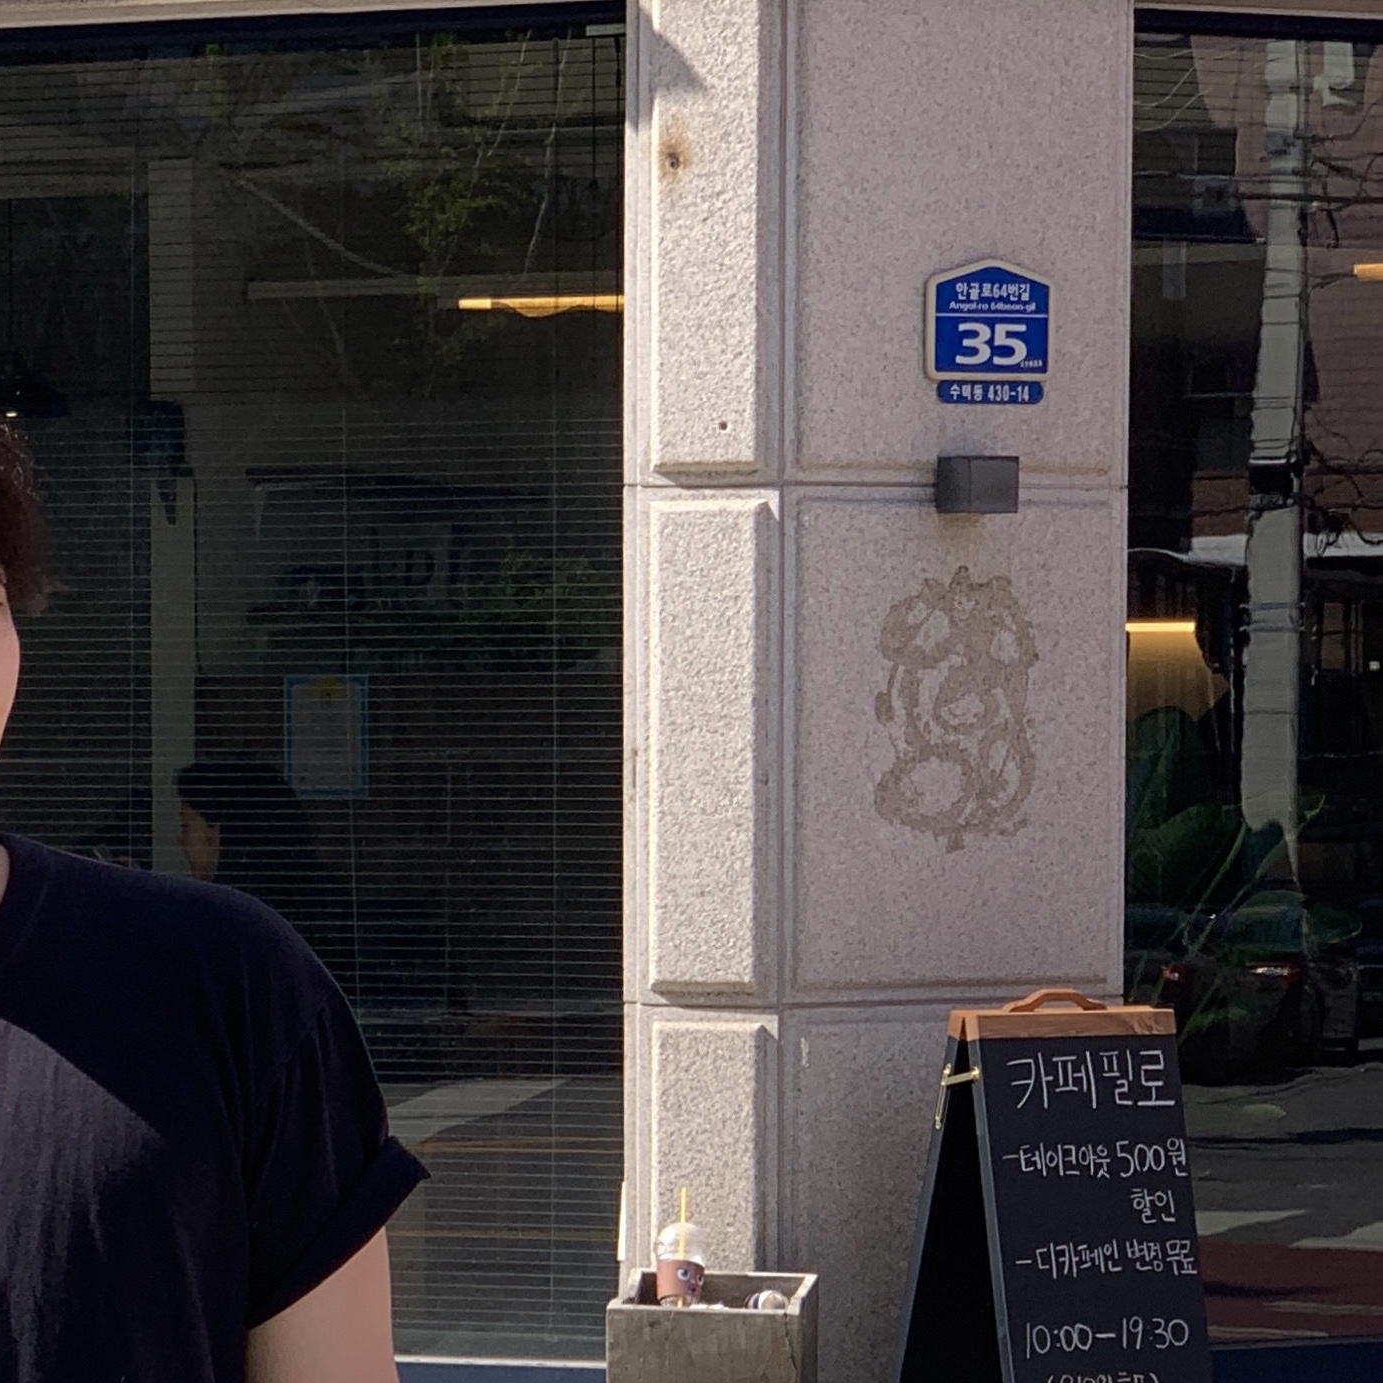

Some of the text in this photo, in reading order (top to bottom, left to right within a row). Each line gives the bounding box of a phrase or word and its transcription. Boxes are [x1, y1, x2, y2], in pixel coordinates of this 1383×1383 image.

[955, 282, 1031, 301] 안골로64번길
[955, 322, 1028, 366] 35
[987, 384, 1030, 401] 430-14
[1006, 1049, 1175, 1109] 카페필로
[1130, 1188, 1176, 1224] 할인
[1125, 1238, 1164, 1272] 변경
[1166, 1240, 1197, 1276] 무료
